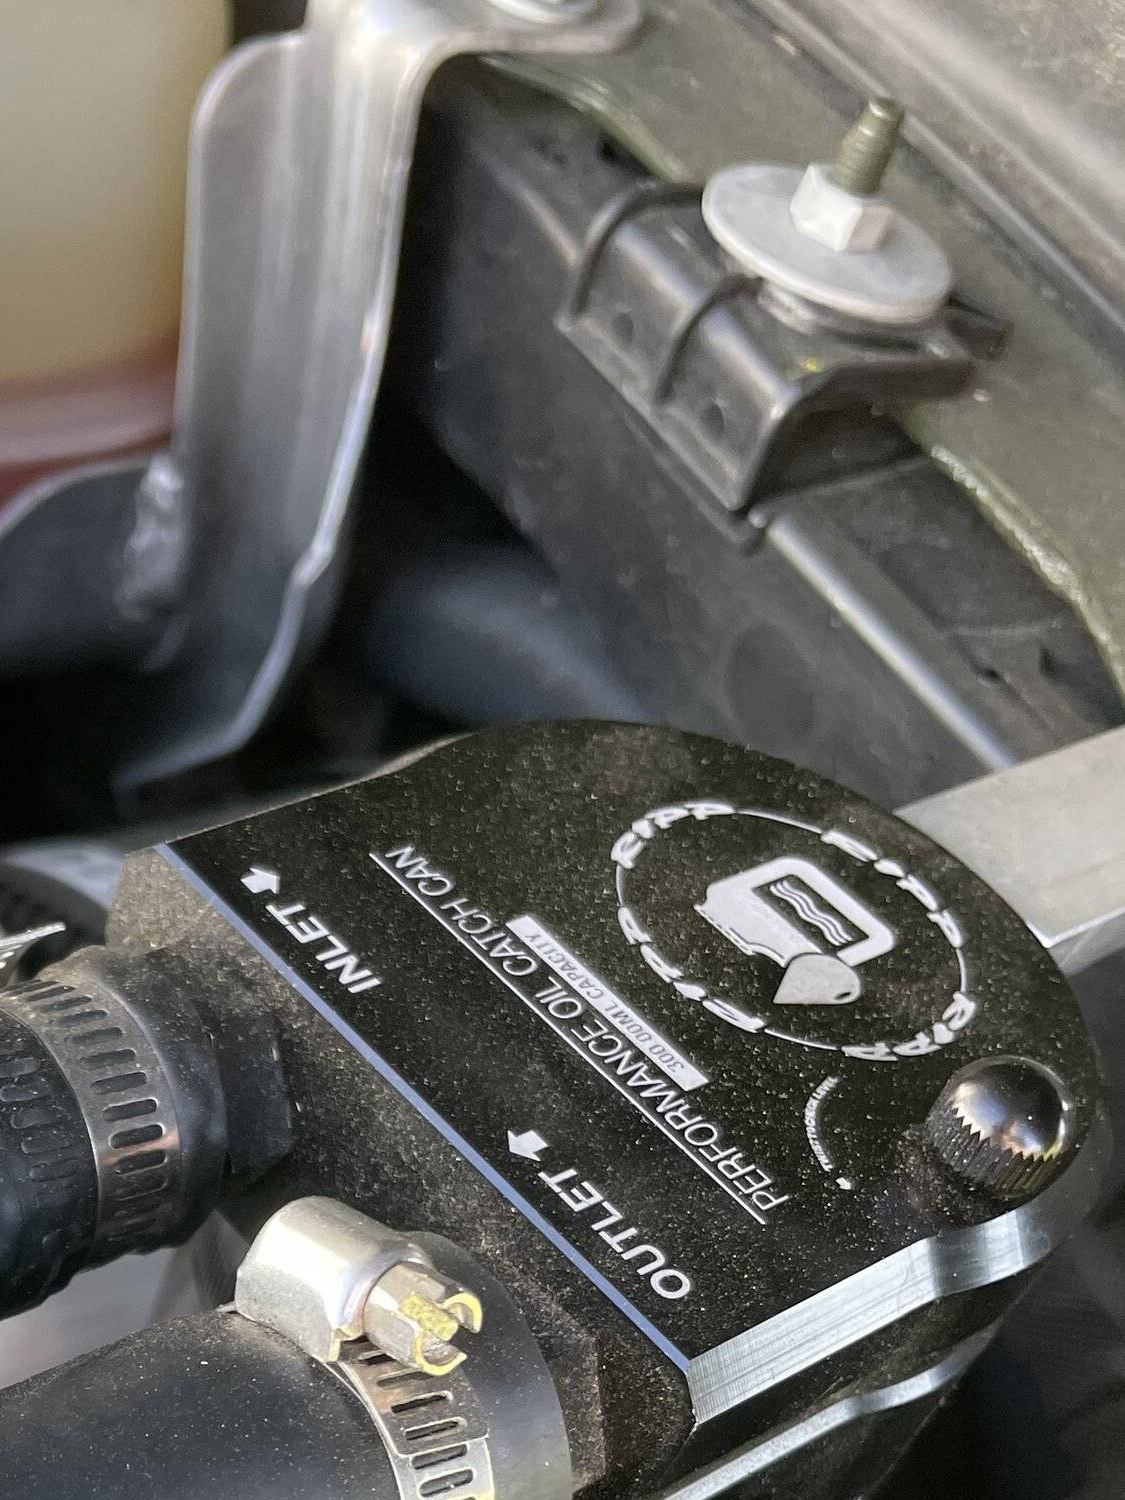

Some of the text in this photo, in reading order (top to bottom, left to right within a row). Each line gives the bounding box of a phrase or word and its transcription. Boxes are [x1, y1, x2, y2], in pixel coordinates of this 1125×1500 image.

[266, 902, 381, 994] INLET
[523, 933, 605, 1000] CAPACITY
[385, 845, 789, 1211] PERFORMANCE OIL CATCH CAN
[537, 1168, 691, 1300] OUTLET
